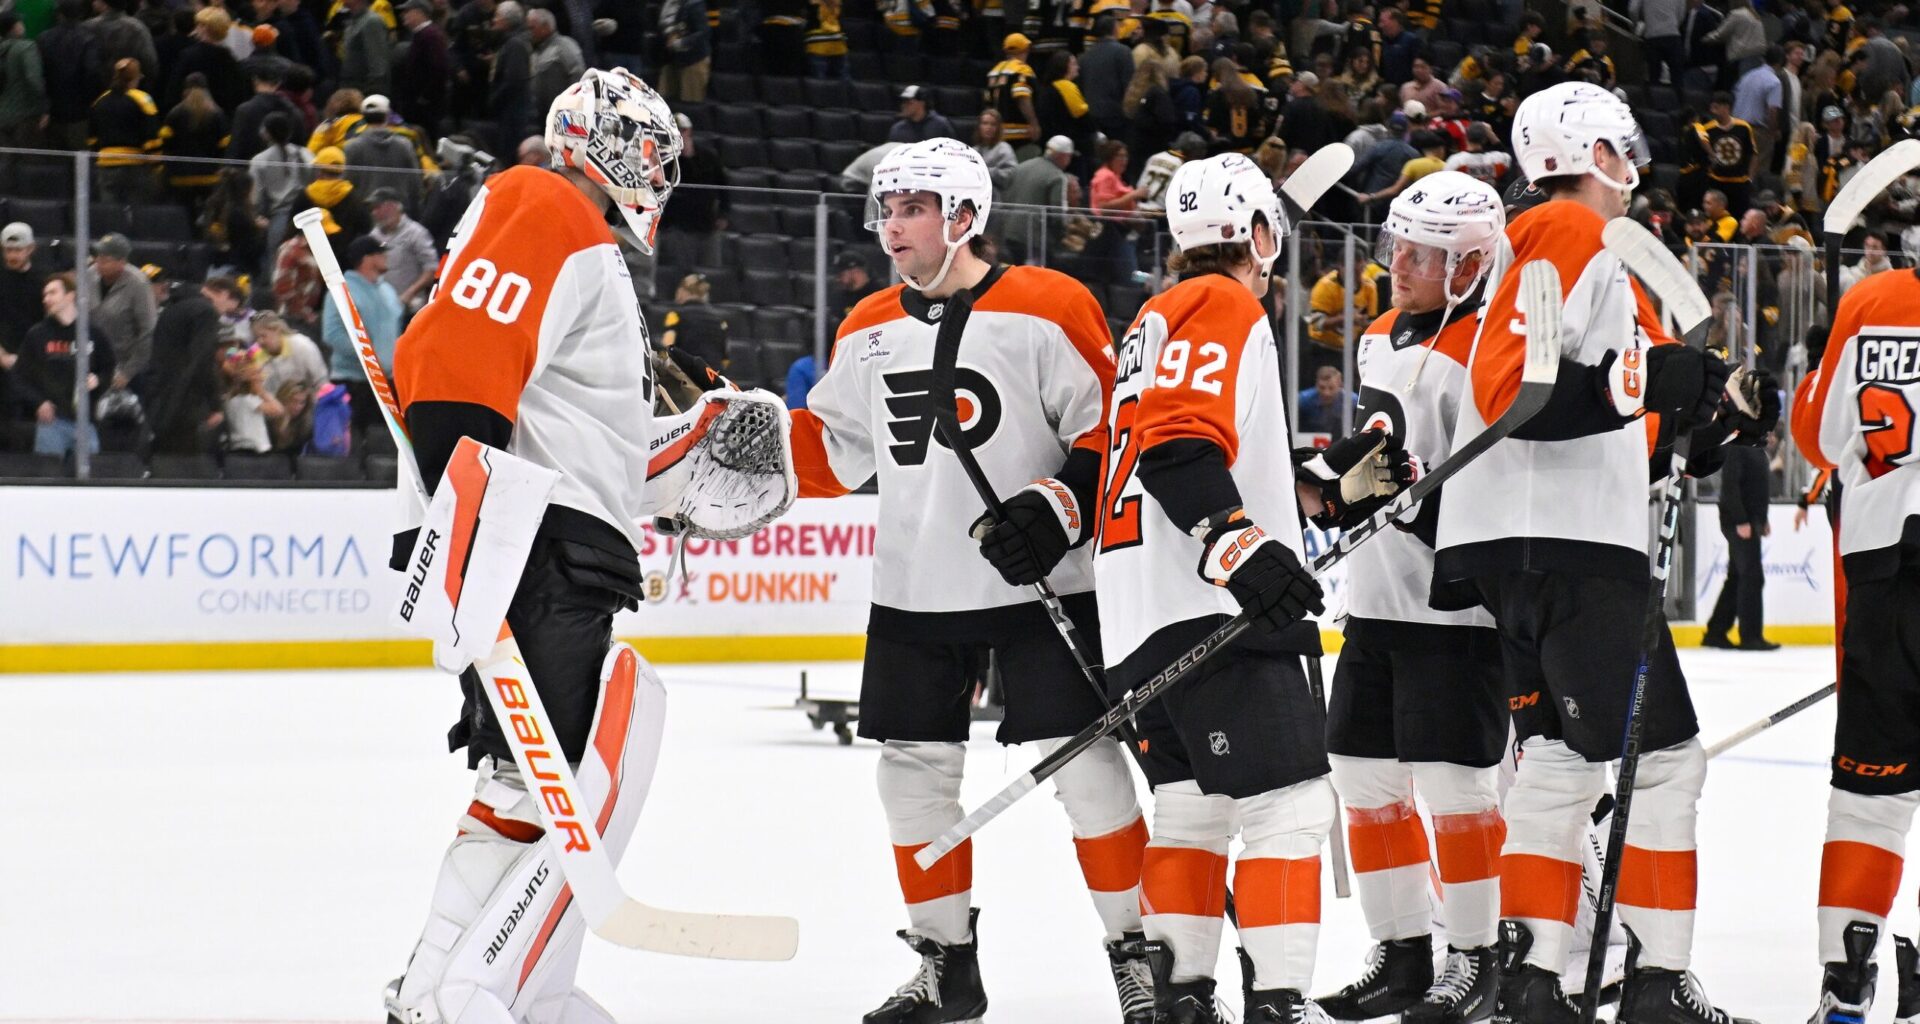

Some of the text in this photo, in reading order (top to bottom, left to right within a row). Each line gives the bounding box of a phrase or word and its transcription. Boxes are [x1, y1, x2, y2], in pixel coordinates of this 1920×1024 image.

[1522, 127, 1530, 145] 5
[587, 132, 641, 188] FLYERS
[1180, 191, 1199, 213] 92
[451, 258, 532, 325] 80
[1155, 339, 1228, 397] 92
[1623, 347, 1641, 398] CC
[1092, 393, 1144, 561] 2
[18, 532, 369, 579] NEWFORMA
[752, 525, 876, 556] BREWI
[1220, 526, 1266, 571] CC
[400, 529, 441, 623] BAUER
[708, 571, 838, 603] DUNKIN'
[198, 588, 371, 614] CONNECTED
[1632, 674, 1648, 718] TRIGGER
[493, 677, 592, 854] BAUER
[1837, 755, 1910, 778] CCM
[483, 860, 550, 967] SUPREME
[1852, 926, 1875, 934] CCM
